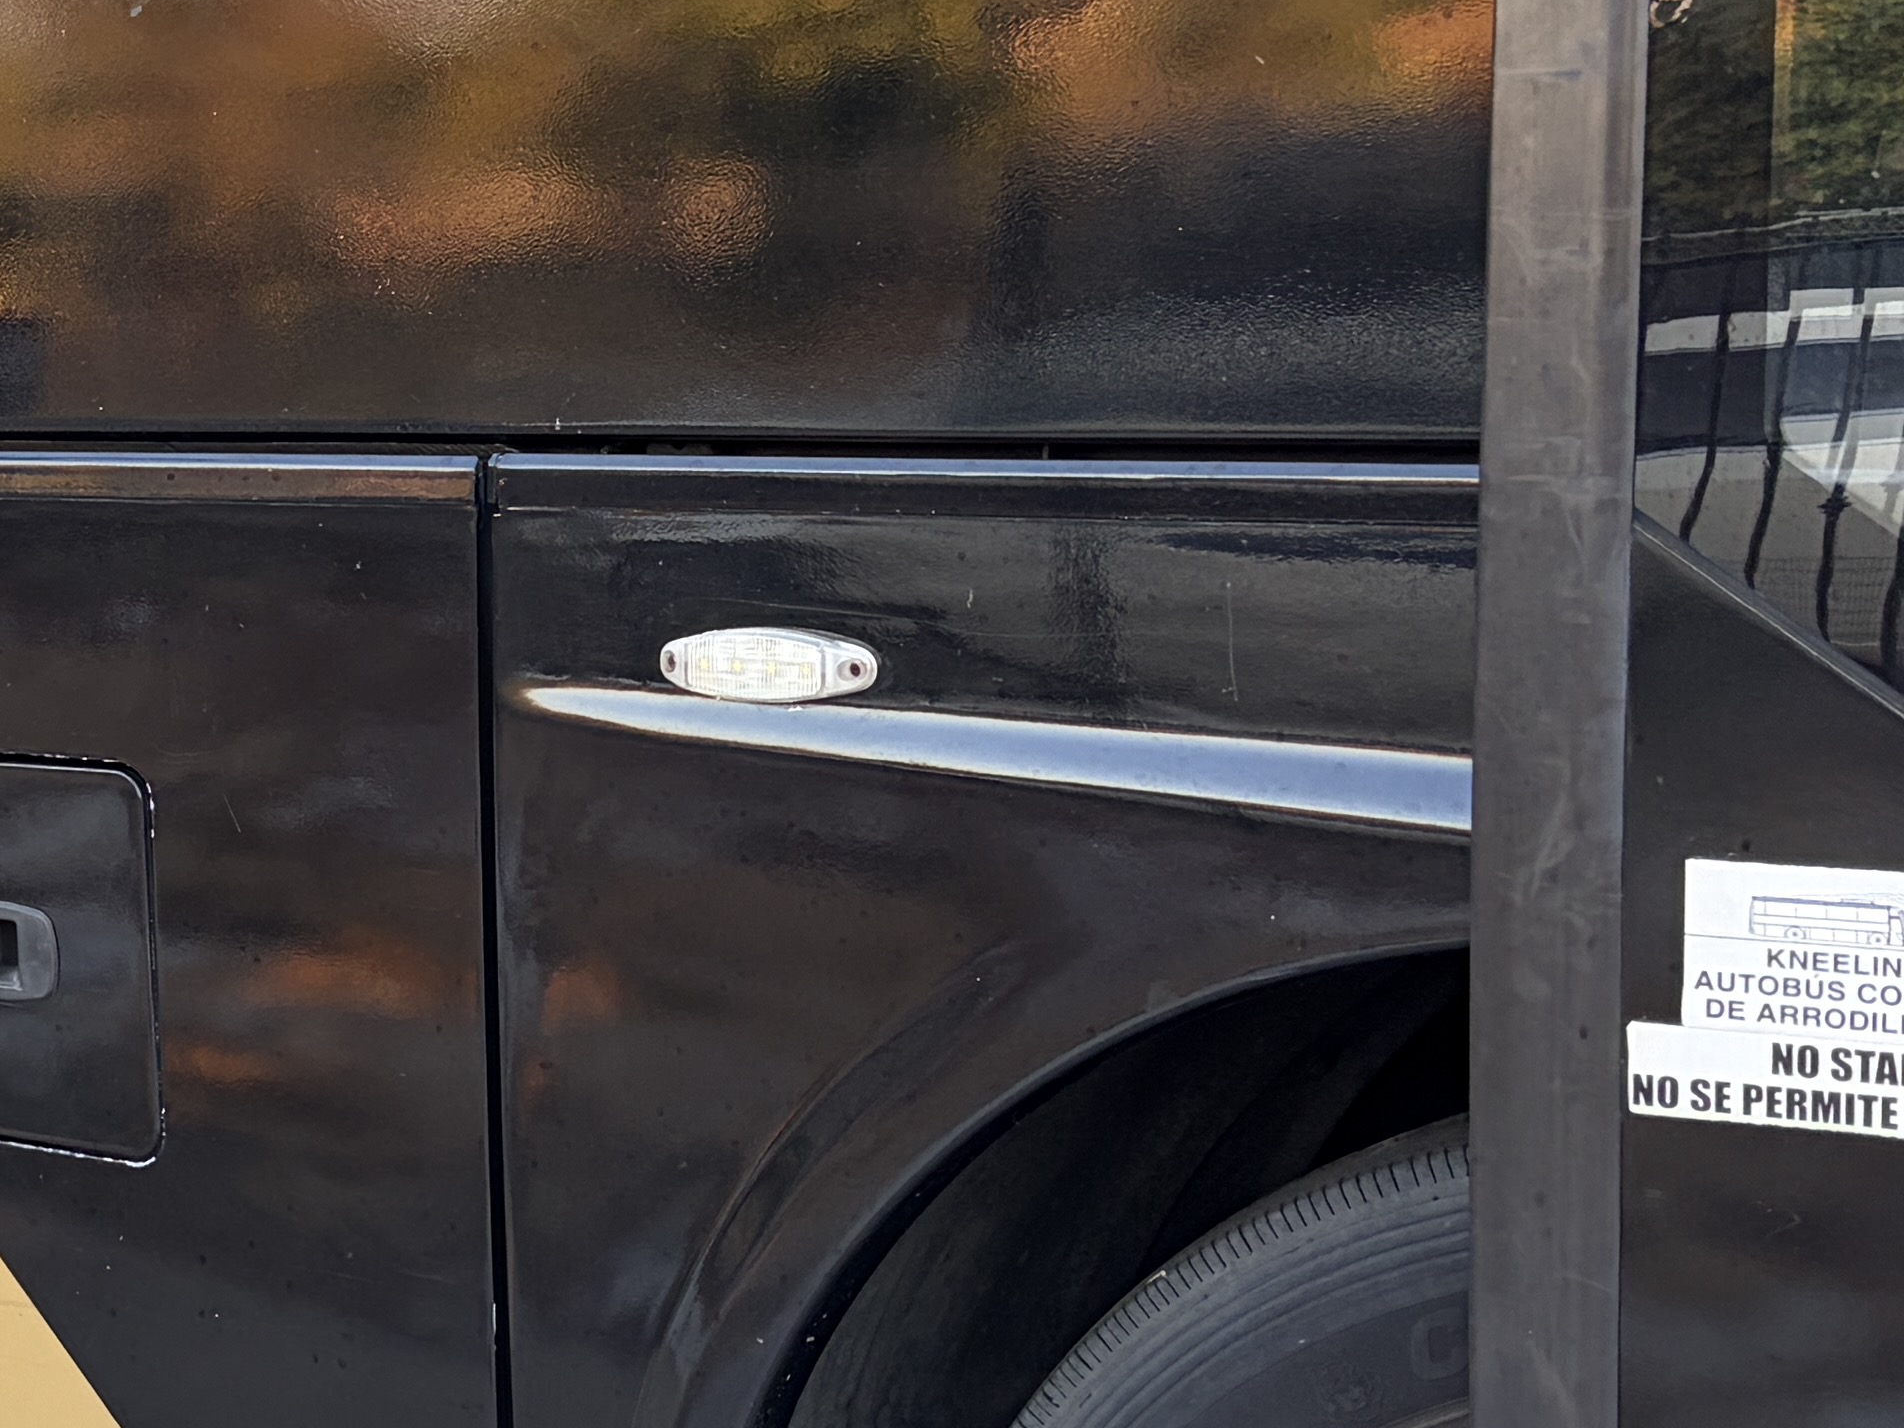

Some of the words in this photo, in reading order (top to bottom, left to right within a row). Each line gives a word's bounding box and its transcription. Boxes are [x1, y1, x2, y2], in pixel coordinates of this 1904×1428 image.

[1693, 969, 1846, 1003] AUTOBÚS
[1705, 997, 1746, 1021] DE
[1756, 1002, 1904, 1036] ARRODIL
[1770, 1041, 1820, 1080] NO
[1830, 1046, 1904, 1087] STA
[1631, 1073, 1679, 1110] NO
[1690, 1078, 1731, 1114] SE
[1742, 1083, 1899, 1131] PERMITE
